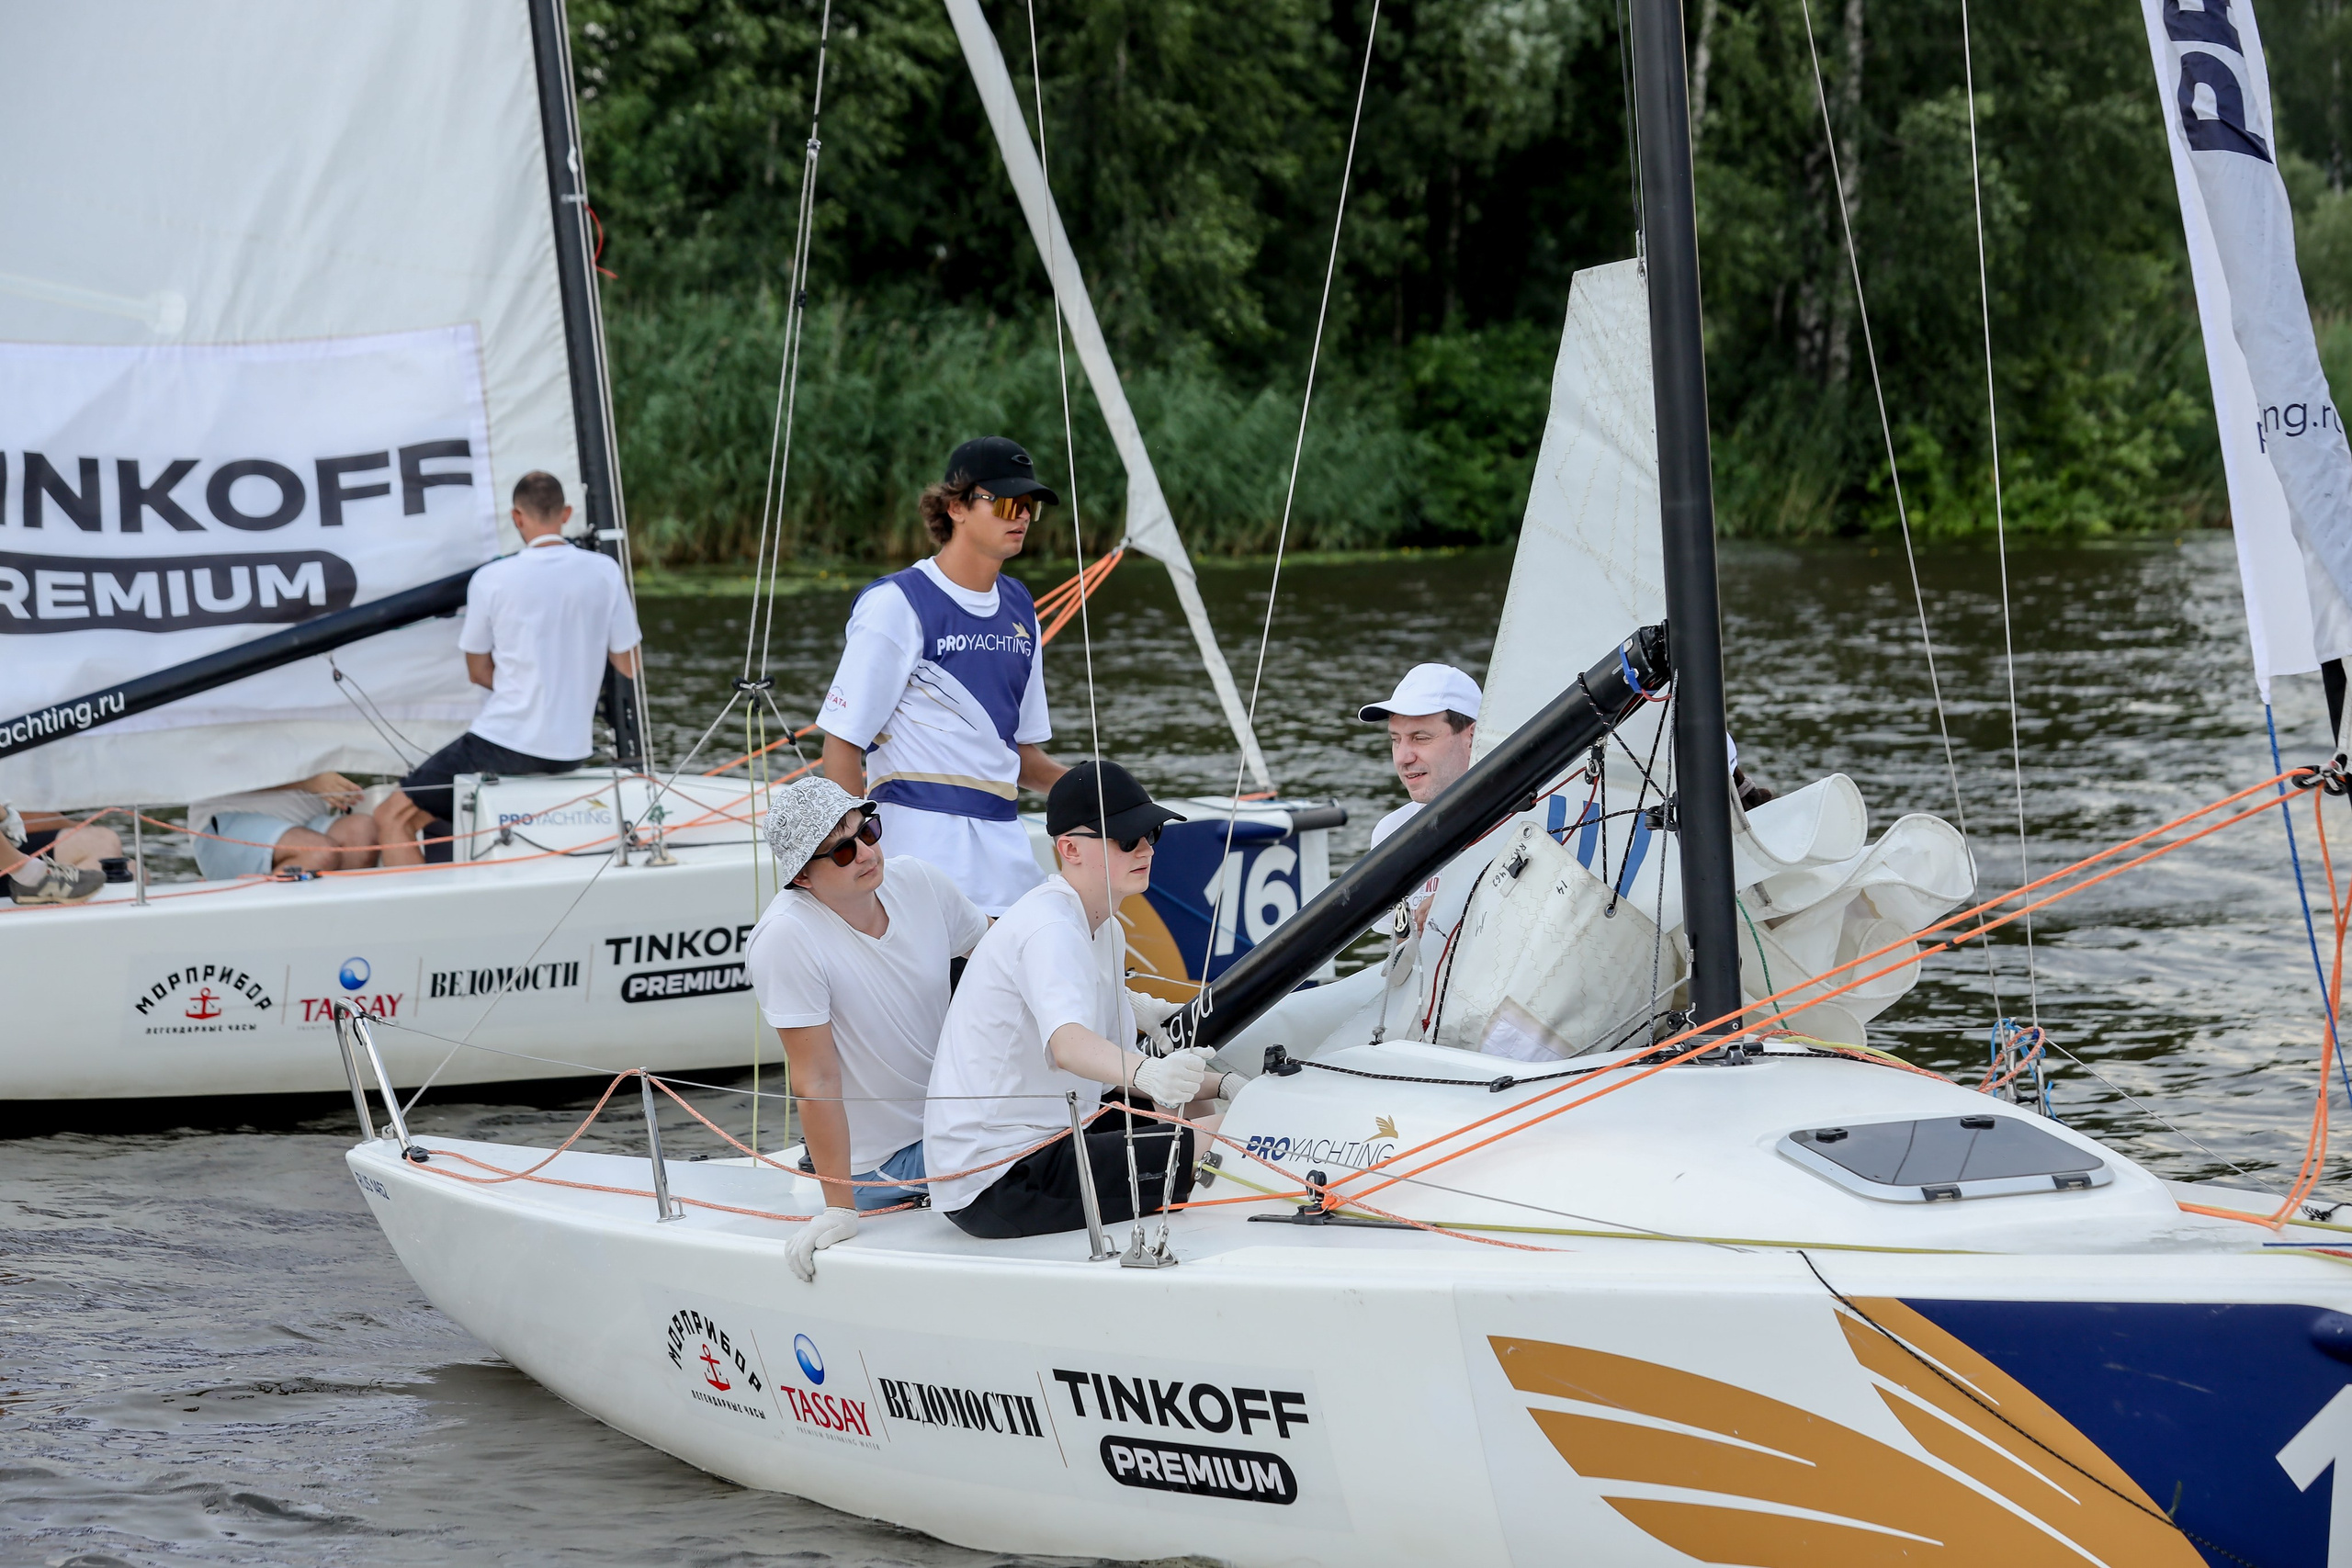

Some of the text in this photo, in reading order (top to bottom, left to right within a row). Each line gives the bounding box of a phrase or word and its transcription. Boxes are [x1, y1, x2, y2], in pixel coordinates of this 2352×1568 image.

[937, 633, 1032, 658] PROYACHTING
[499, 810, 612, 827] PROYACHTING
[1203, 844, 1298, 957] 16
[135, 964, 273, 1016] МОРПРИБОР
[430, 961, 580, 998] ВЕДОМОСТИ
[628, 967, 751, 998] PREMIUM
[1242, 1135, 1395, 1168] PROYACHTING
[667, 1309, 763, 1393] МОРПРИБОР
[691, 1389, 743, 1413] ЛЕГЕНДАРНЫЕ
[781, 1385, 872, 1437] TASSAY
[877, 1378, 1045, 1438] ВЕДОМОСТИ
[1052, 1368, 1309, 1439] TINKOFF
[797, 1426, 881, 1451] PREMIUM DRINKING WATER
[1110, 1444, 1286, 1495] PREMIUM
